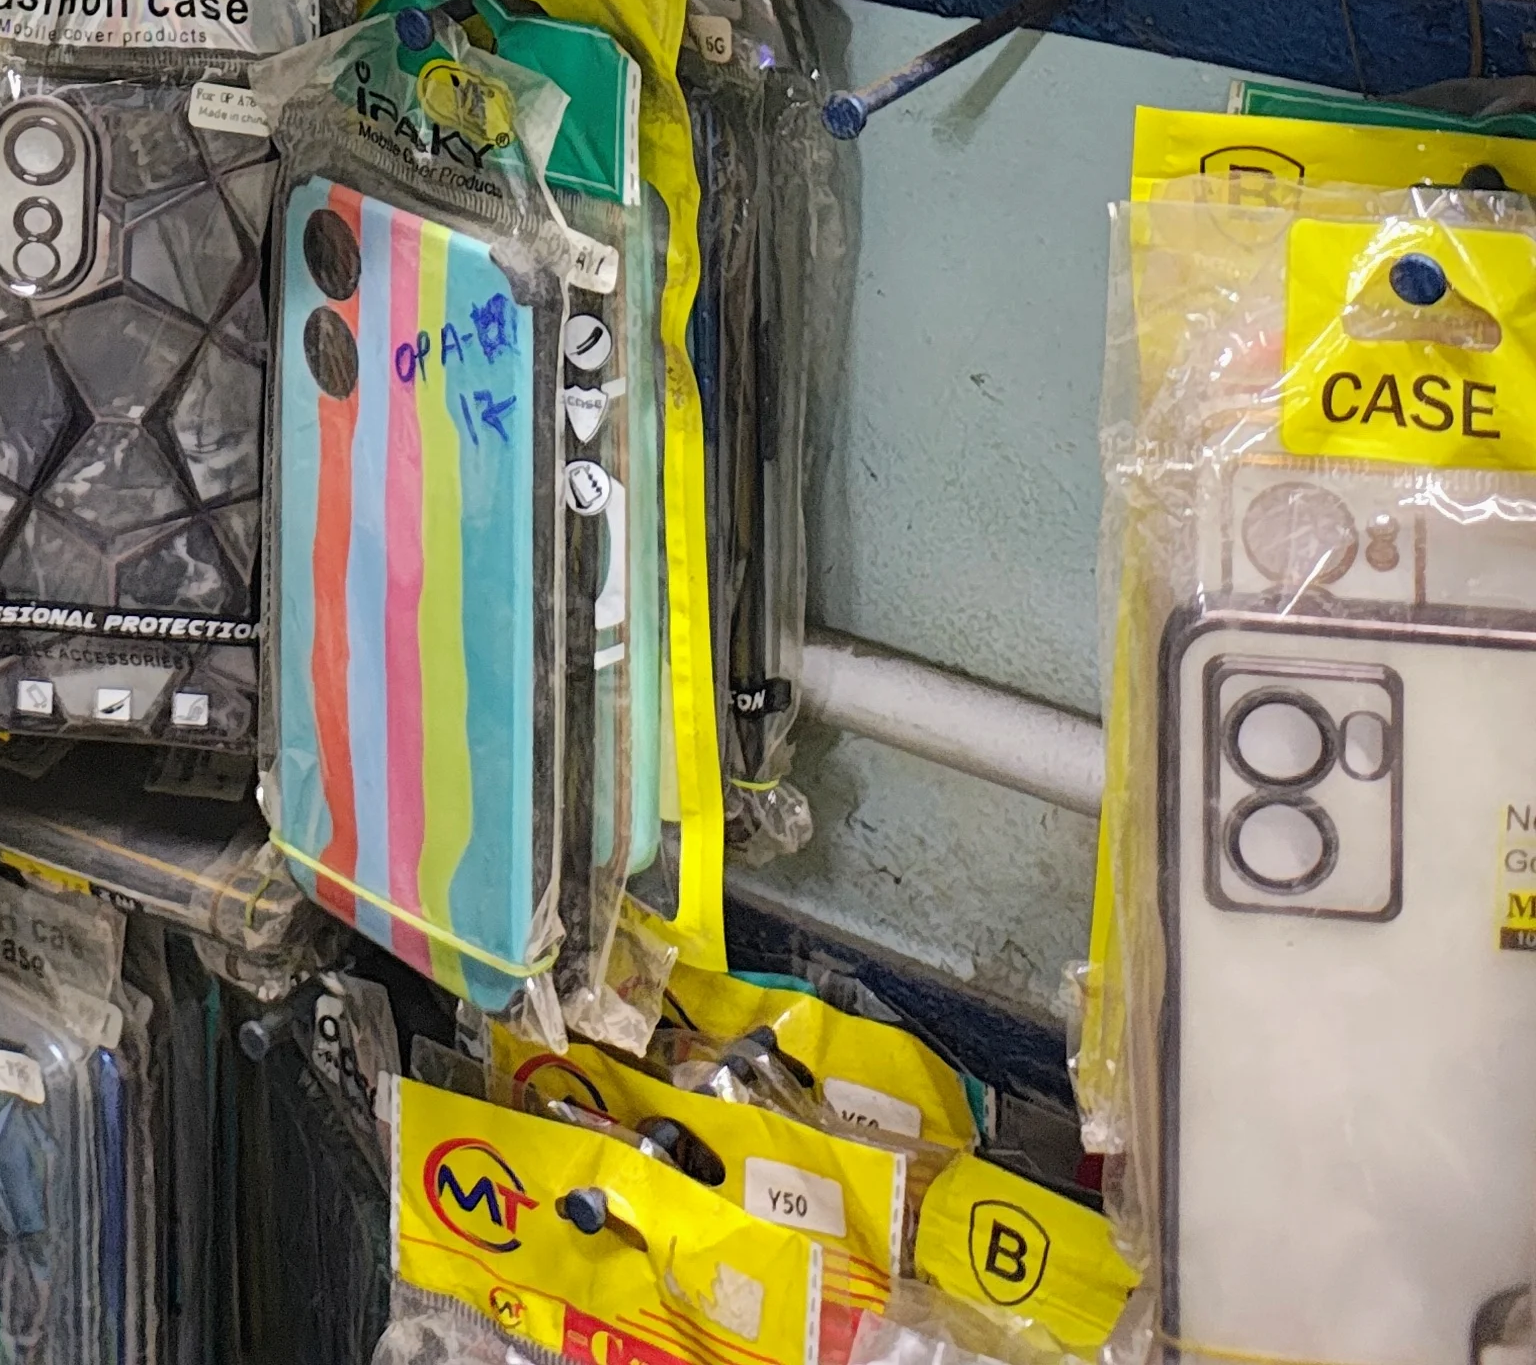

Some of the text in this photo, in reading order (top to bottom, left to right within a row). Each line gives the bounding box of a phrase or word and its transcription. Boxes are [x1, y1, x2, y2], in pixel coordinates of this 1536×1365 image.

[63, 28, 114, 42] cover
[123, 29, 207, 46] products
[358, 121, 401, 157] Mobile
[1321, 370, 1502, 440] CASE
[768, 1187, 808, 1217] Y50
[986, 1219, 1028, 1283] B
